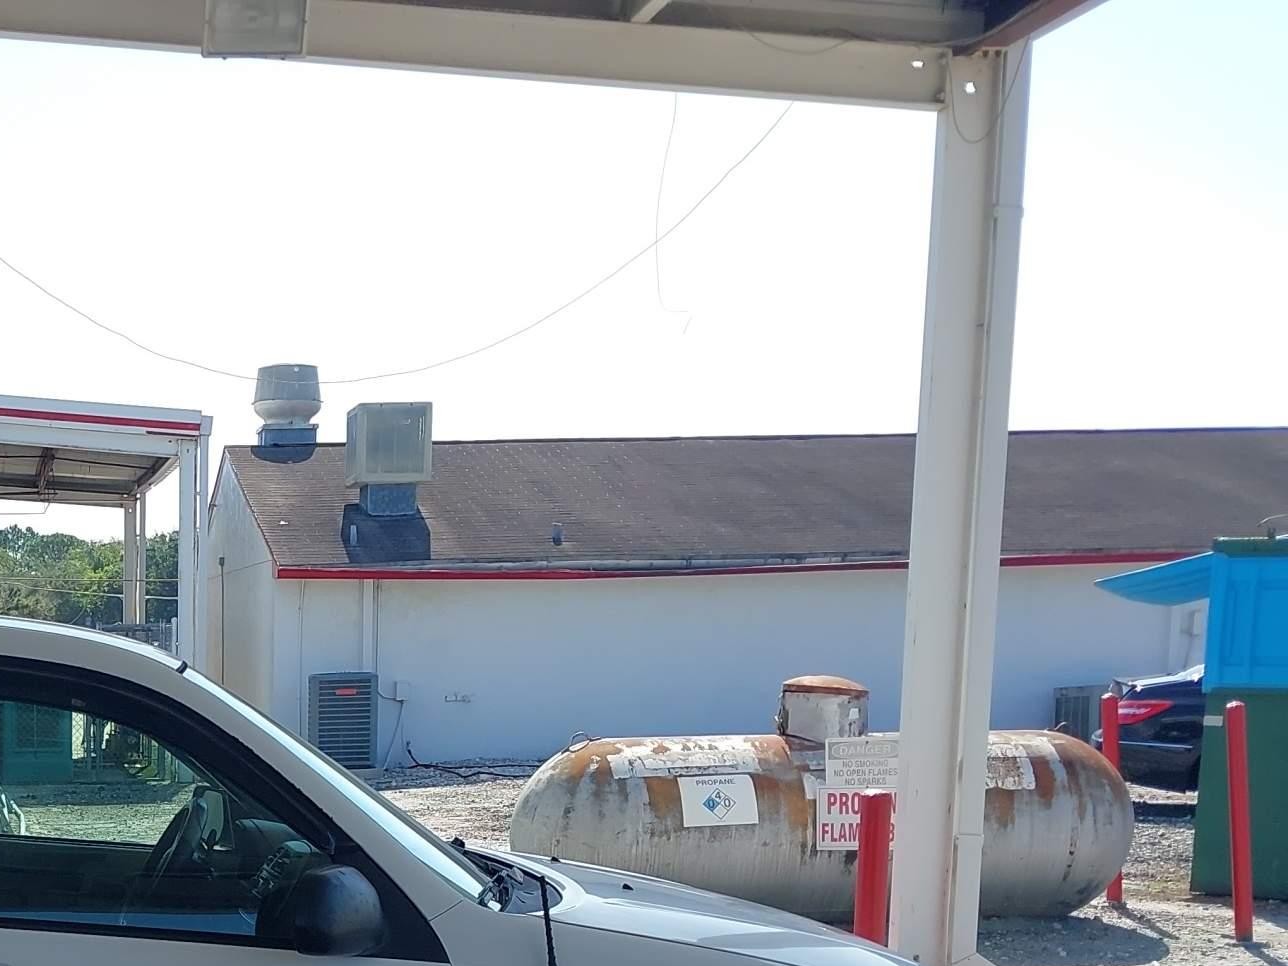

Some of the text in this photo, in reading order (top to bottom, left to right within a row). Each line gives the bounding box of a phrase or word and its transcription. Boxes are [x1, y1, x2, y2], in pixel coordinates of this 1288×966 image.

[839, 744, 890, 756] DANGER
[842, 760, 889, 768] NO SMOKING
[833, 768, 898, 777] NO OPEN FLAMES
[695, 778, 736, 786] PROPANE
[845, 777, 887, 786] NO SPARKS
[714, 791, 722, 800] 4
[707, 798, 731, 808] 0 0
